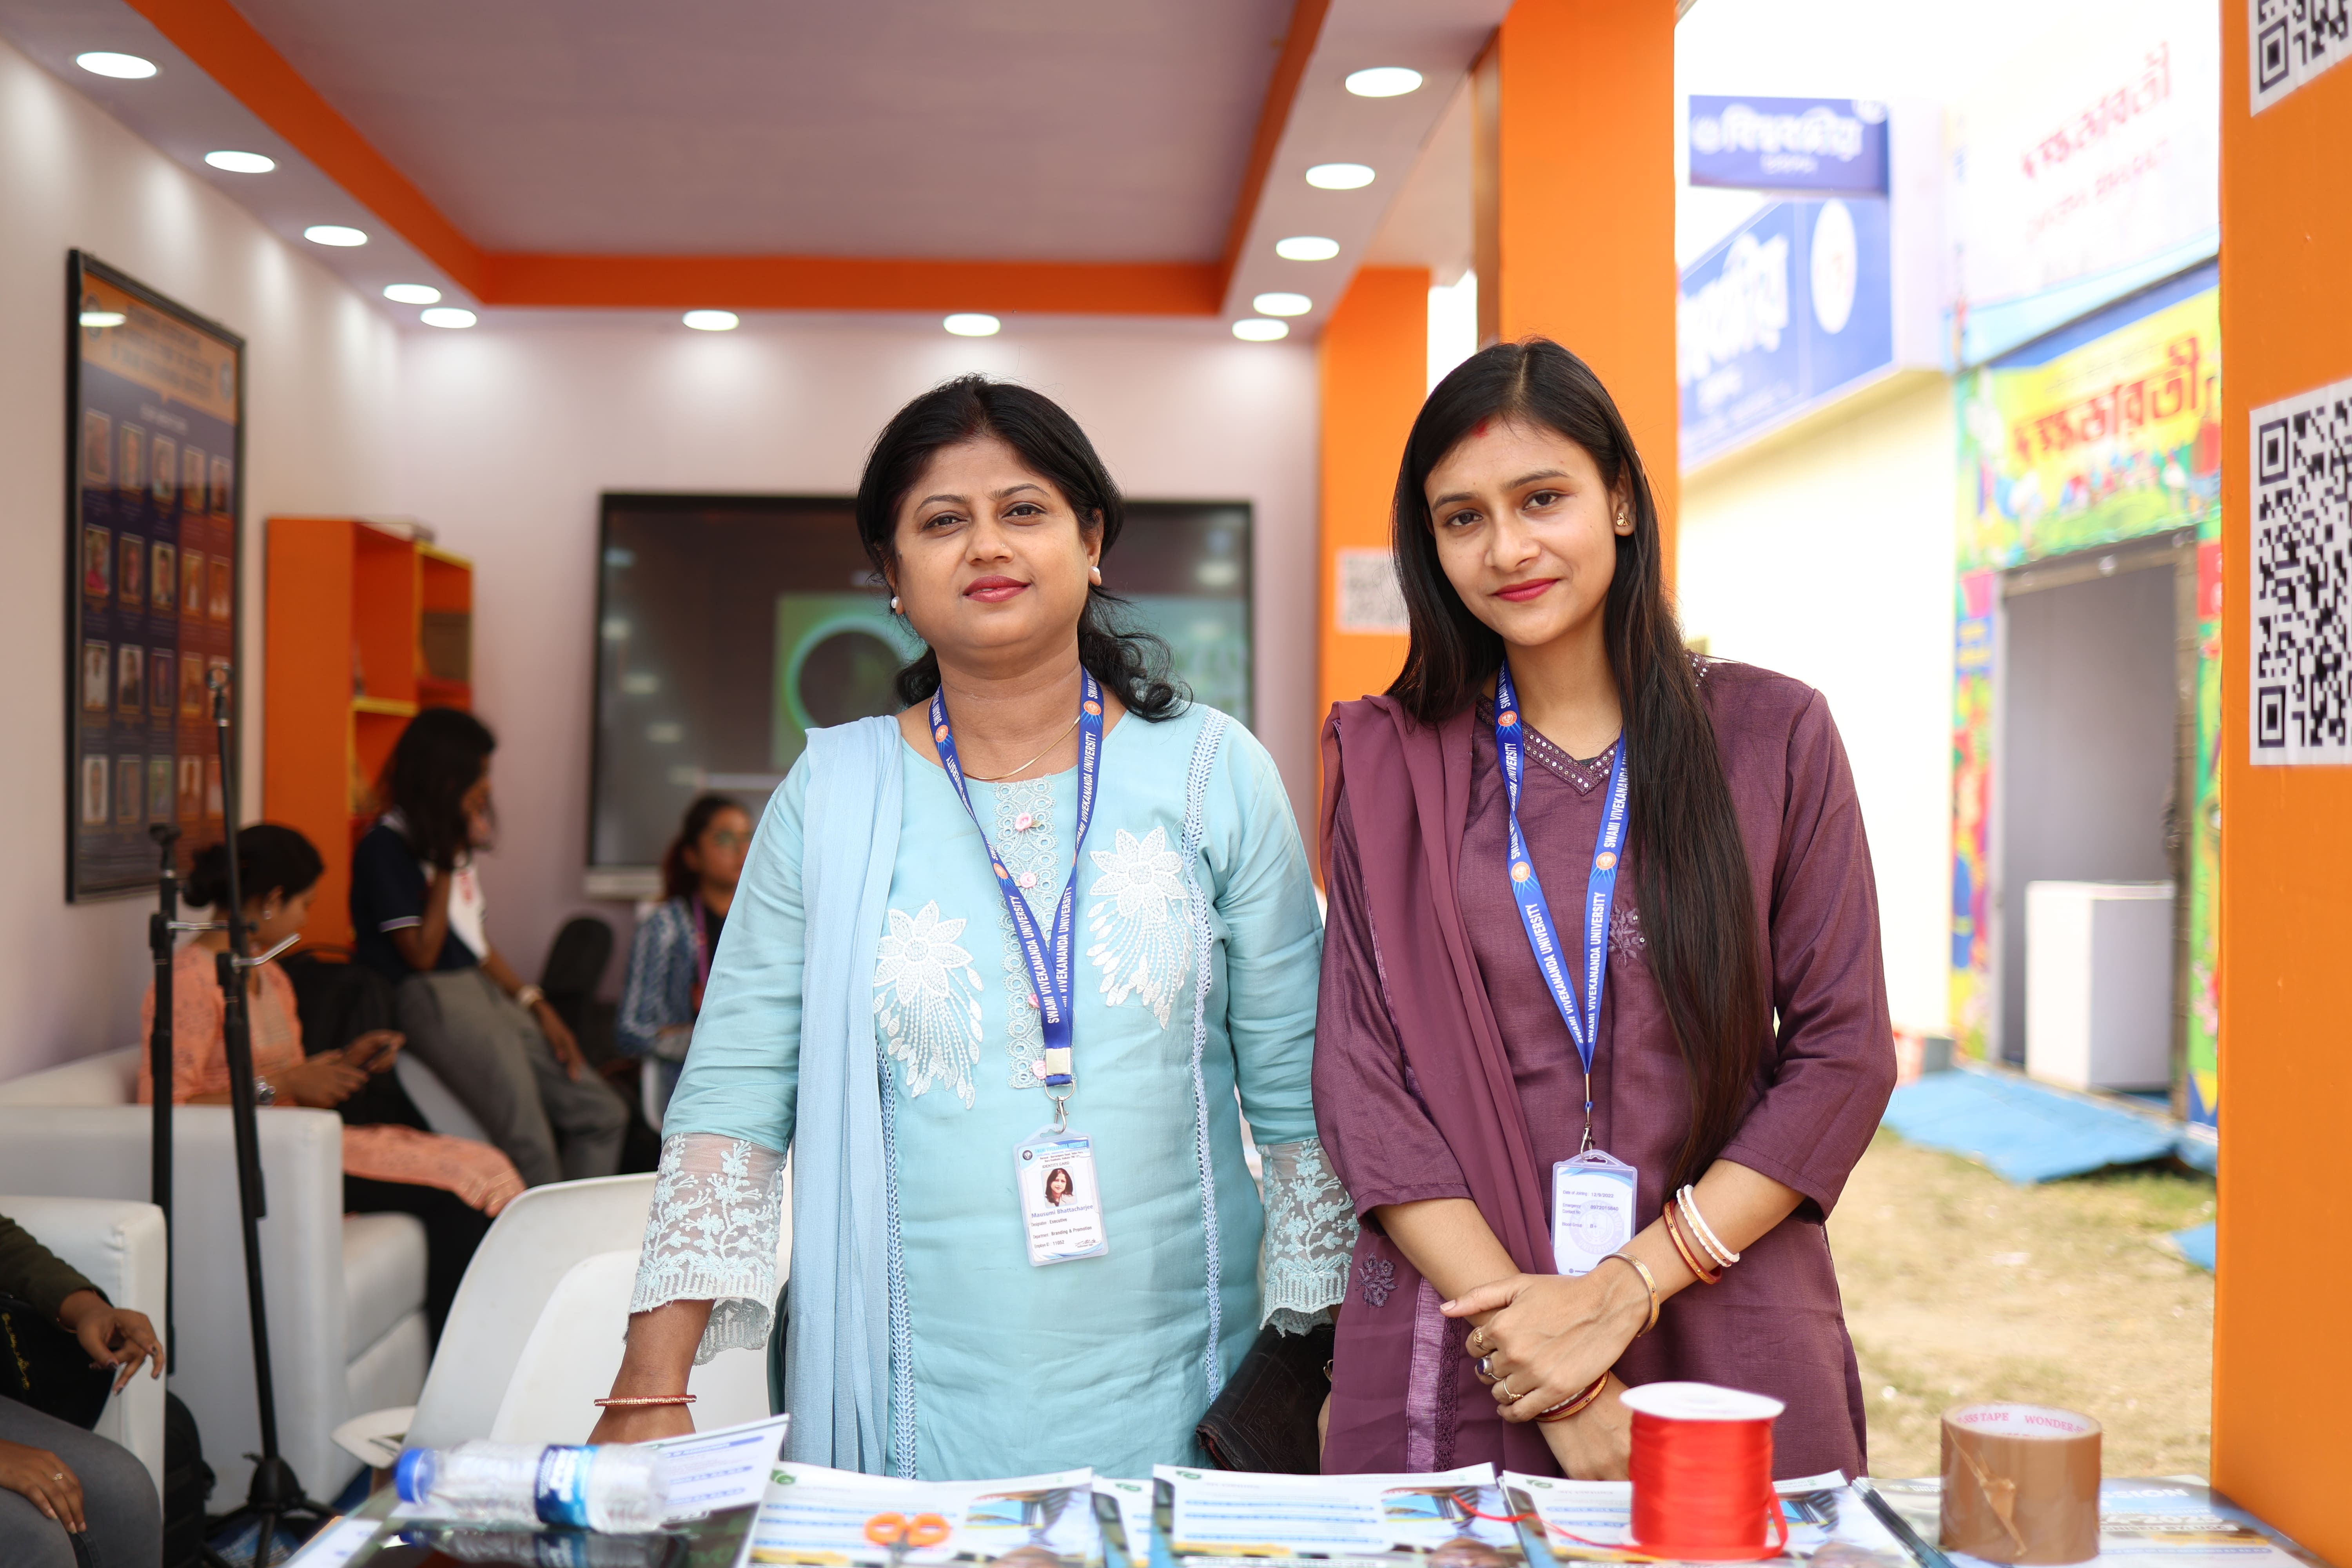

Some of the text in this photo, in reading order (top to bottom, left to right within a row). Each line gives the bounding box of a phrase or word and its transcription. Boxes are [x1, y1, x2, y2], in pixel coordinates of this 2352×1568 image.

[1087, 678, 1098, 699] SWAMI
[1499, 684, 1511, 709] SWAMI
[932, 705, 942, 726] SWAMI
[1083, 731, 1096, 773] UNIVERSITY
[1504, 743, 1517, 782] UNIVERSITY
[946, 755, 964, 795] UNIVERSITY
[1081, 772, 1093, 823] VIVEKANANDA
[1511, 832, 1521, 860] SWAMI
[1604, 822, 1621, 848] SWAMI
[1590, 892, 1606, 945] UNIVERSITY
[1009, 895, 1060, 1024] SWAMI VIVEKANANDA UNIVERSITY
[1056, 887, 1072, 993] VIVEKANANDA UNIVERSITY
[1525, 903, 1583, 1044] SWAMI VIVEKANANDA UNIVERSITY
[1588, 947, 1601, 1011] VIVEKANANDA
[1031, 1205, 1093, 1218] Mausumi Bhattacharjee
[1980, 1413, 2009, 1422] TAPE
